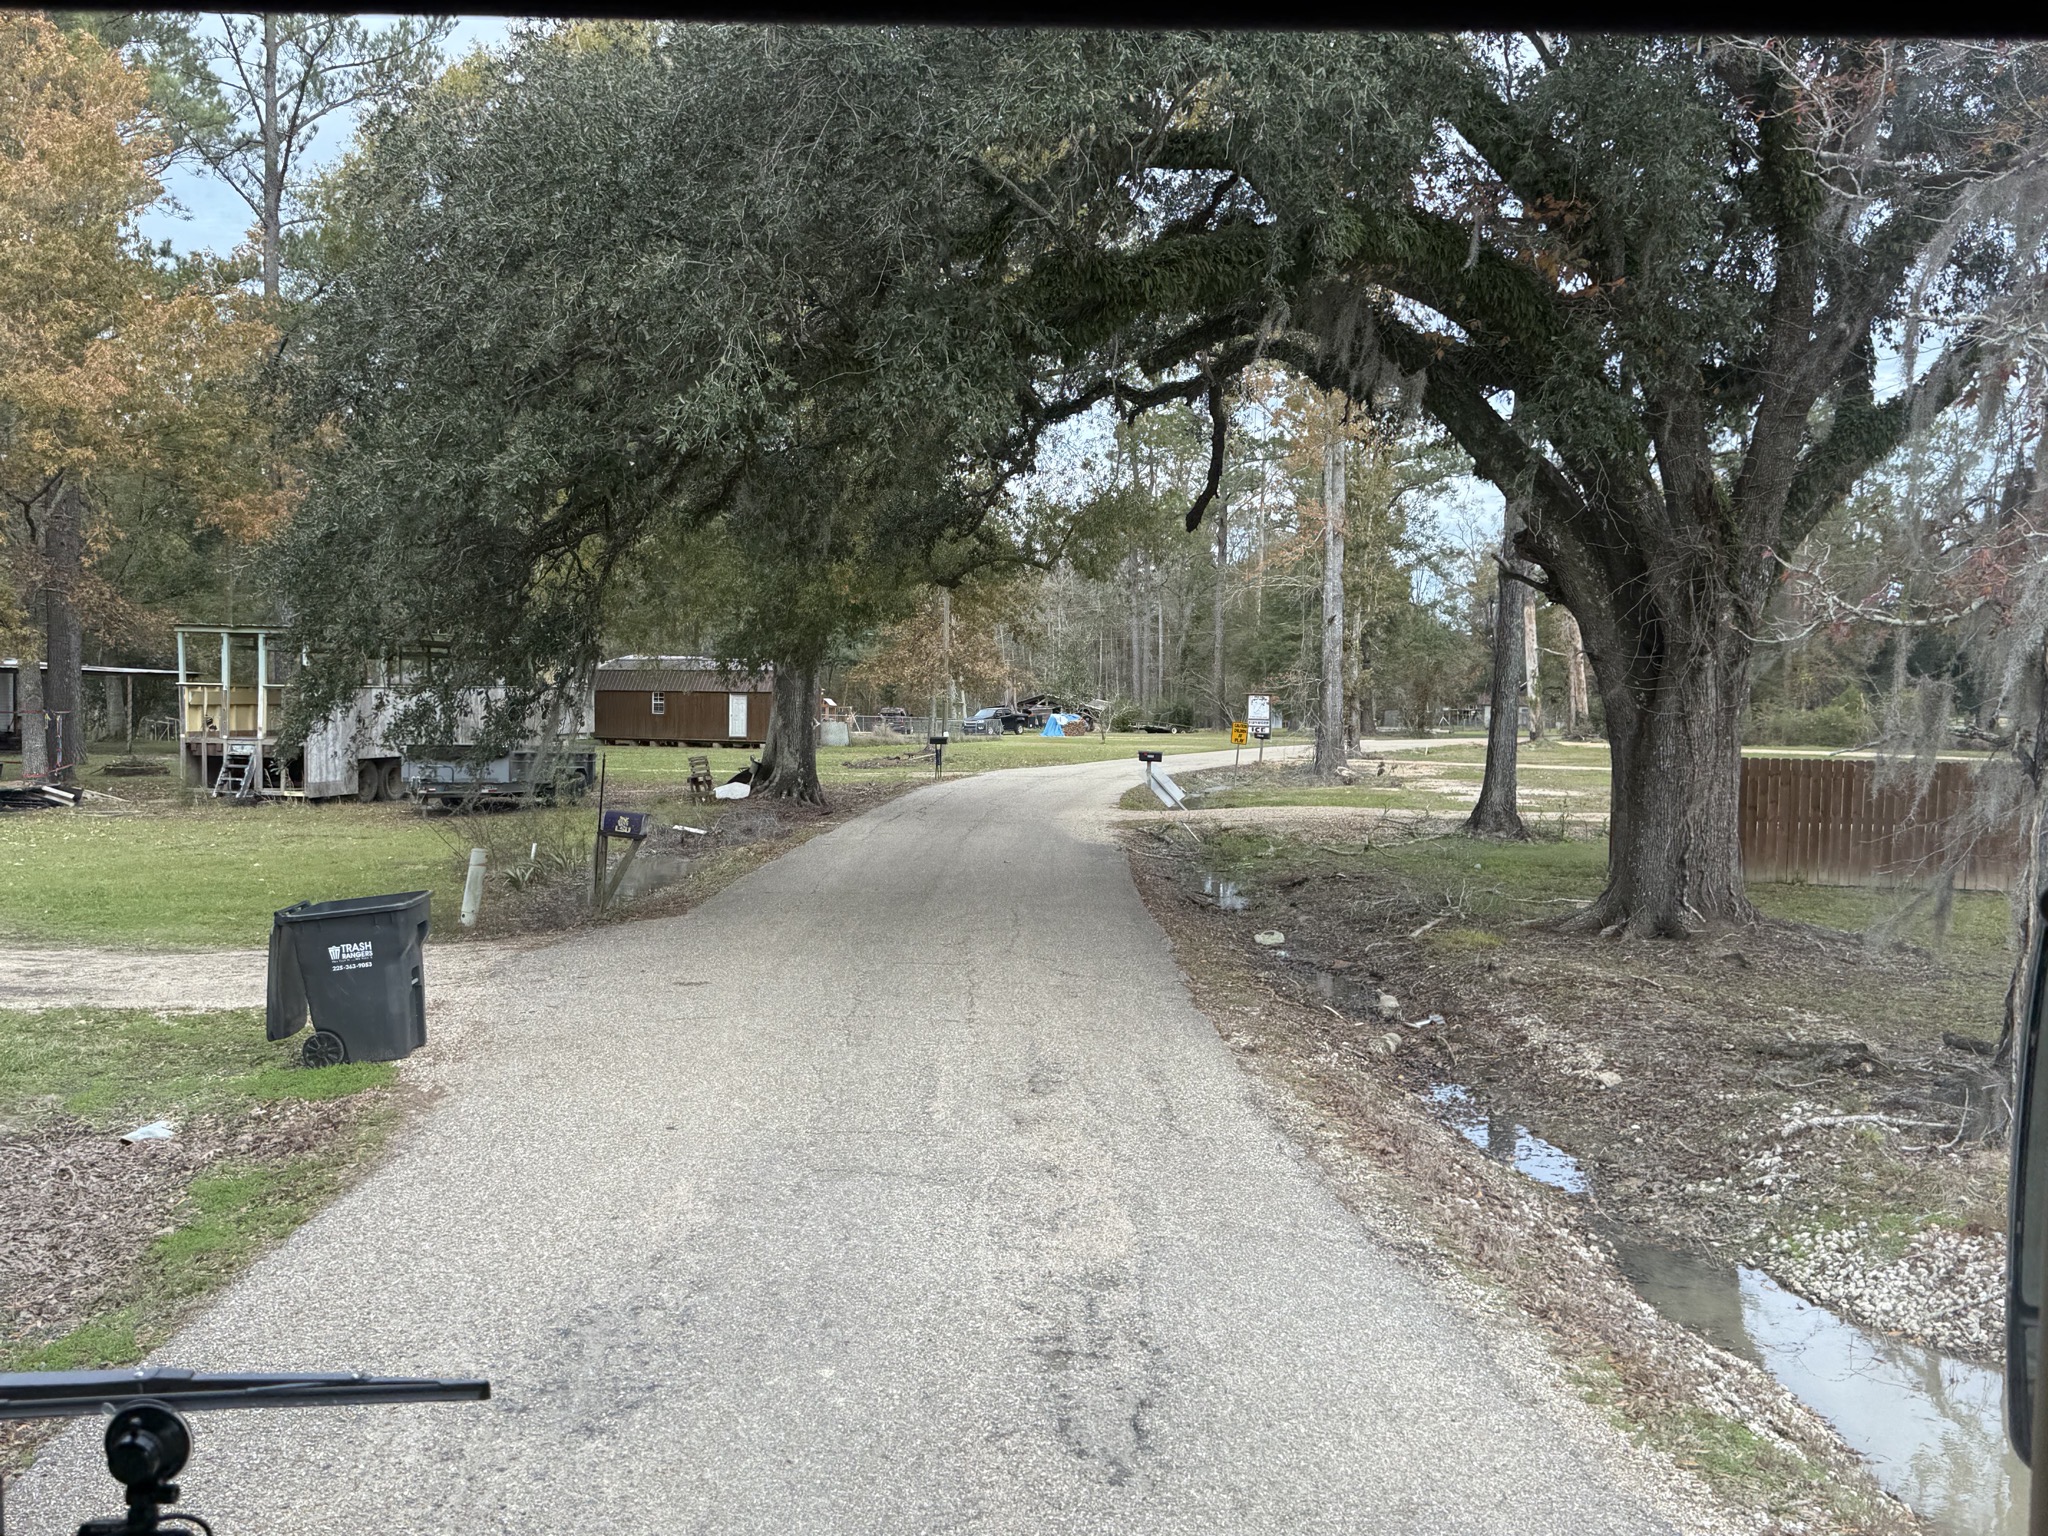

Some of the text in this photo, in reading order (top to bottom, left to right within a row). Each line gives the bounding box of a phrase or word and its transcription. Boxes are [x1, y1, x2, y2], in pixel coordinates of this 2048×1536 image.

[615, 825, 631, 833] LSU
[340, 941, 372, 953] TRASH
[341, 950, 373, 960] RANGERS
[332, 962, 372, 971] 225-363-9053
